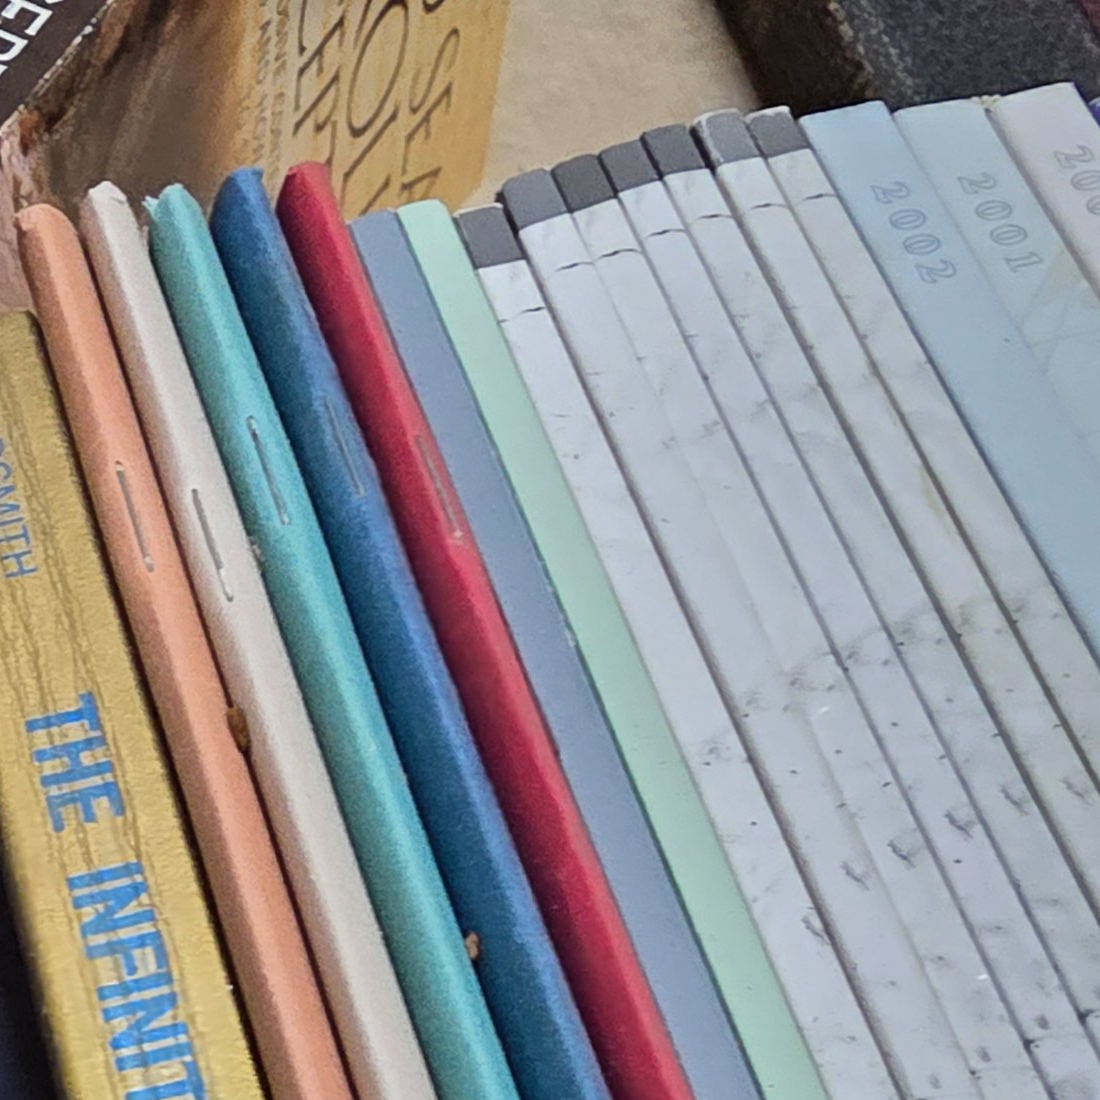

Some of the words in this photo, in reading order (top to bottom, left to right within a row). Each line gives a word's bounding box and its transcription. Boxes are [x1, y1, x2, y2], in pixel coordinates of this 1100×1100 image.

[870, 180, 958, 285] 2002
[956, 171, 1044, 274] 2001
[24, 690, 126, 834] THE
